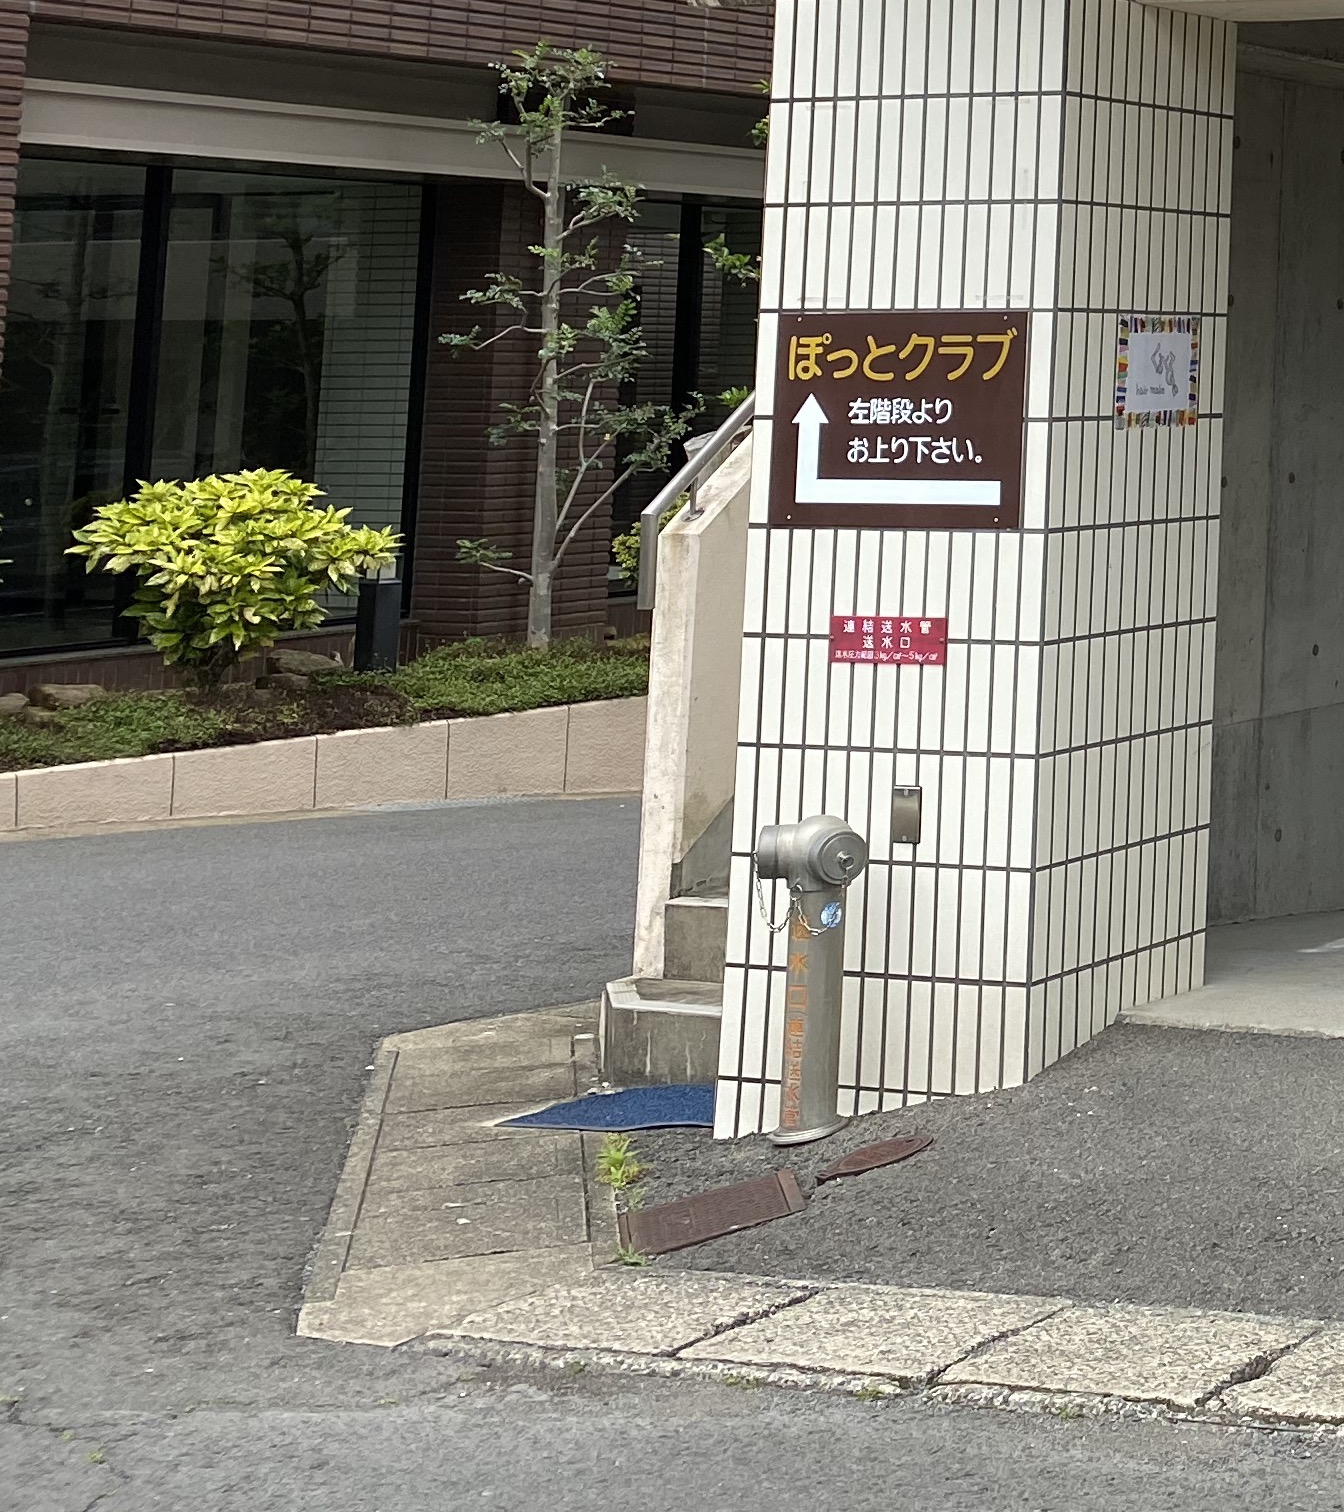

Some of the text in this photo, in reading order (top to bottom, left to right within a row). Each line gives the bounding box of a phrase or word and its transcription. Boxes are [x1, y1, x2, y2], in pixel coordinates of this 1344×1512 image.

[788, 327, 1018, 381] ぽっとクラブ
[1136, 384, 1148, 395] hair
[848, 397, 952, 424] 左階段より
[847, 436, 983, 464] お上り下さい。
[843, 619, 931, 634] 連結送水管
[862, 634, 911, 649] 送水口
